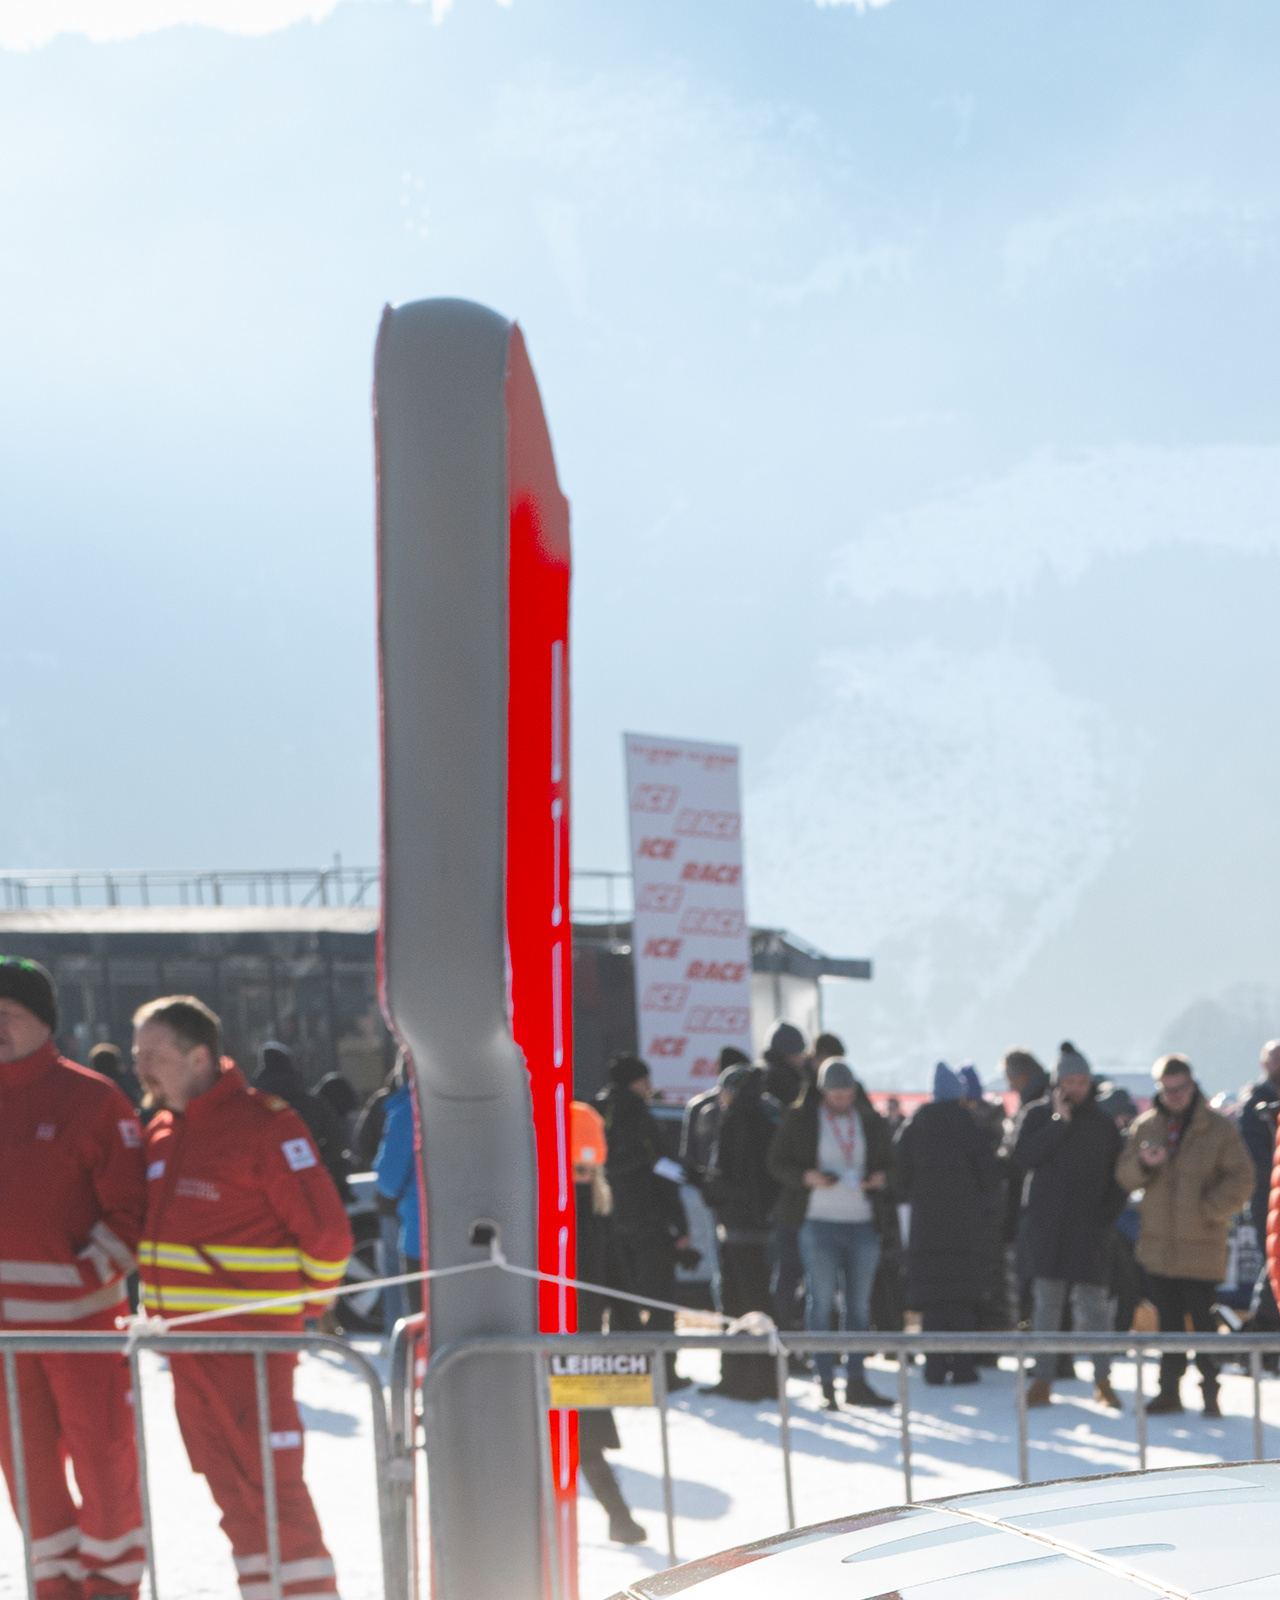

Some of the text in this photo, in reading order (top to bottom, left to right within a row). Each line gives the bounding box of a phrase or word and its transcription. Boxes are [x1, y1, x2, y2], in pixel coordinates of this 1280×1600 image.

[680, 861, 743, 886] RACE
[684, 959, 748, 984] RACE
[689, 1058, 721, 1079] RA
[552, 1354, 647, 1375] LEIRICH
